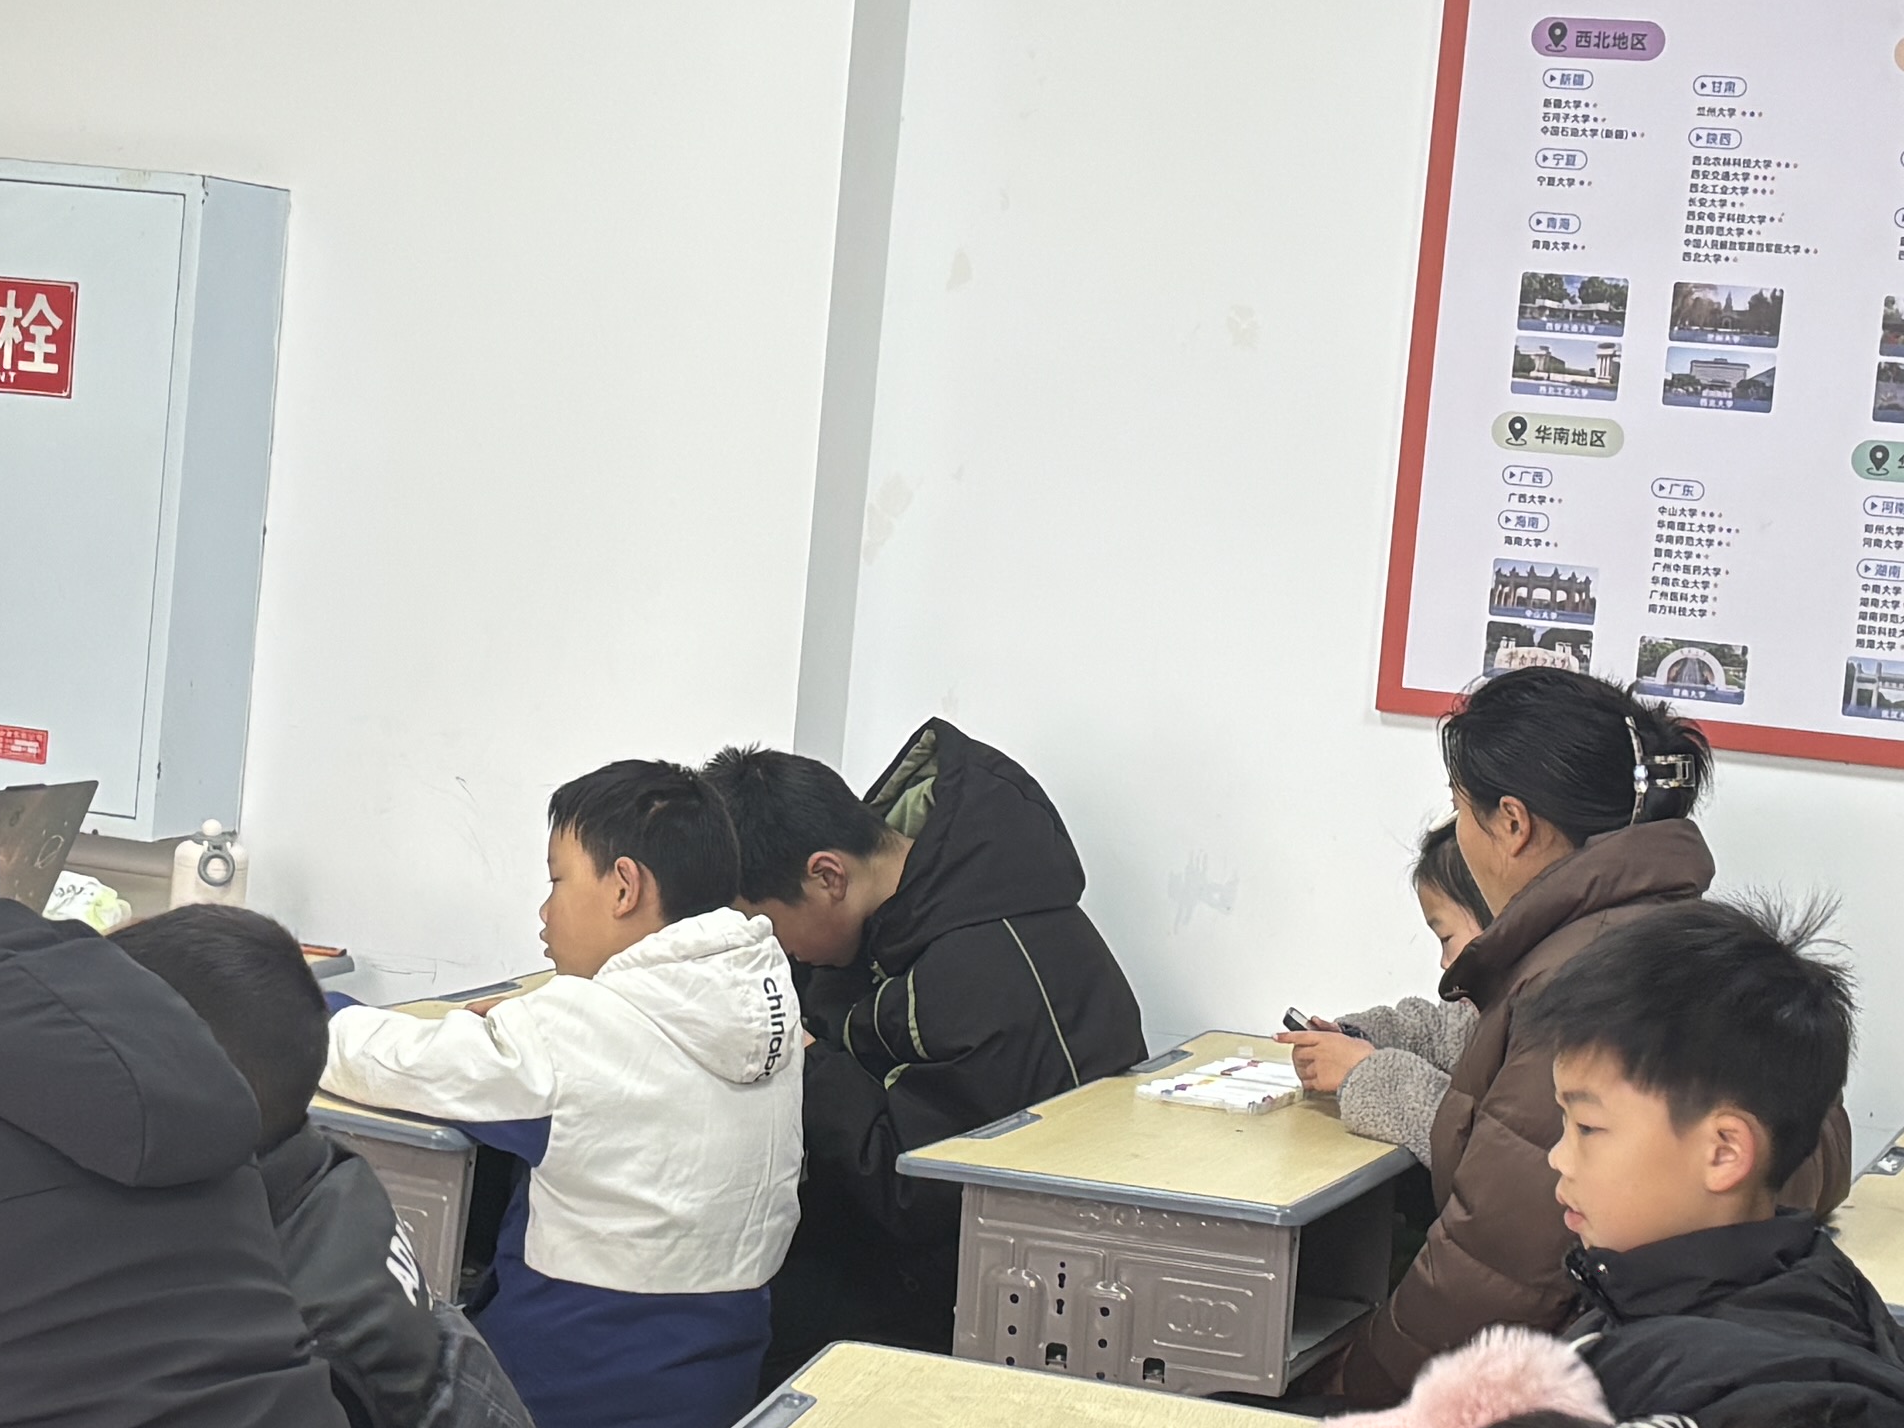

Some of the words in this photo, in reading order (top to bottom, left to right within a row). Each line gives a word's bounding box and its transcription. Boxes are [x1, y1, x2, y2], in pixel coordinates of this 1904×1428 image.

[1575, 30, 1647, 52] 西北地区
[1712, 80, 1736, 94] 甘肃
[1552, 154, 1576, 166] 宁夏
[1535, 425, 1607, 448] 华南地区
[1519, 471, 1543, 484] 广西
[1669, 483, 1694, 497] 广东
[1508, 493, 1546, 504] 广西大学
[1658, 506, 1697, 518] 中山大学
[1515, 516, 1539, 529] 海南
[1875, 564, 1901, 578] 湖南
[764, 977, 786, 1076] chinab
